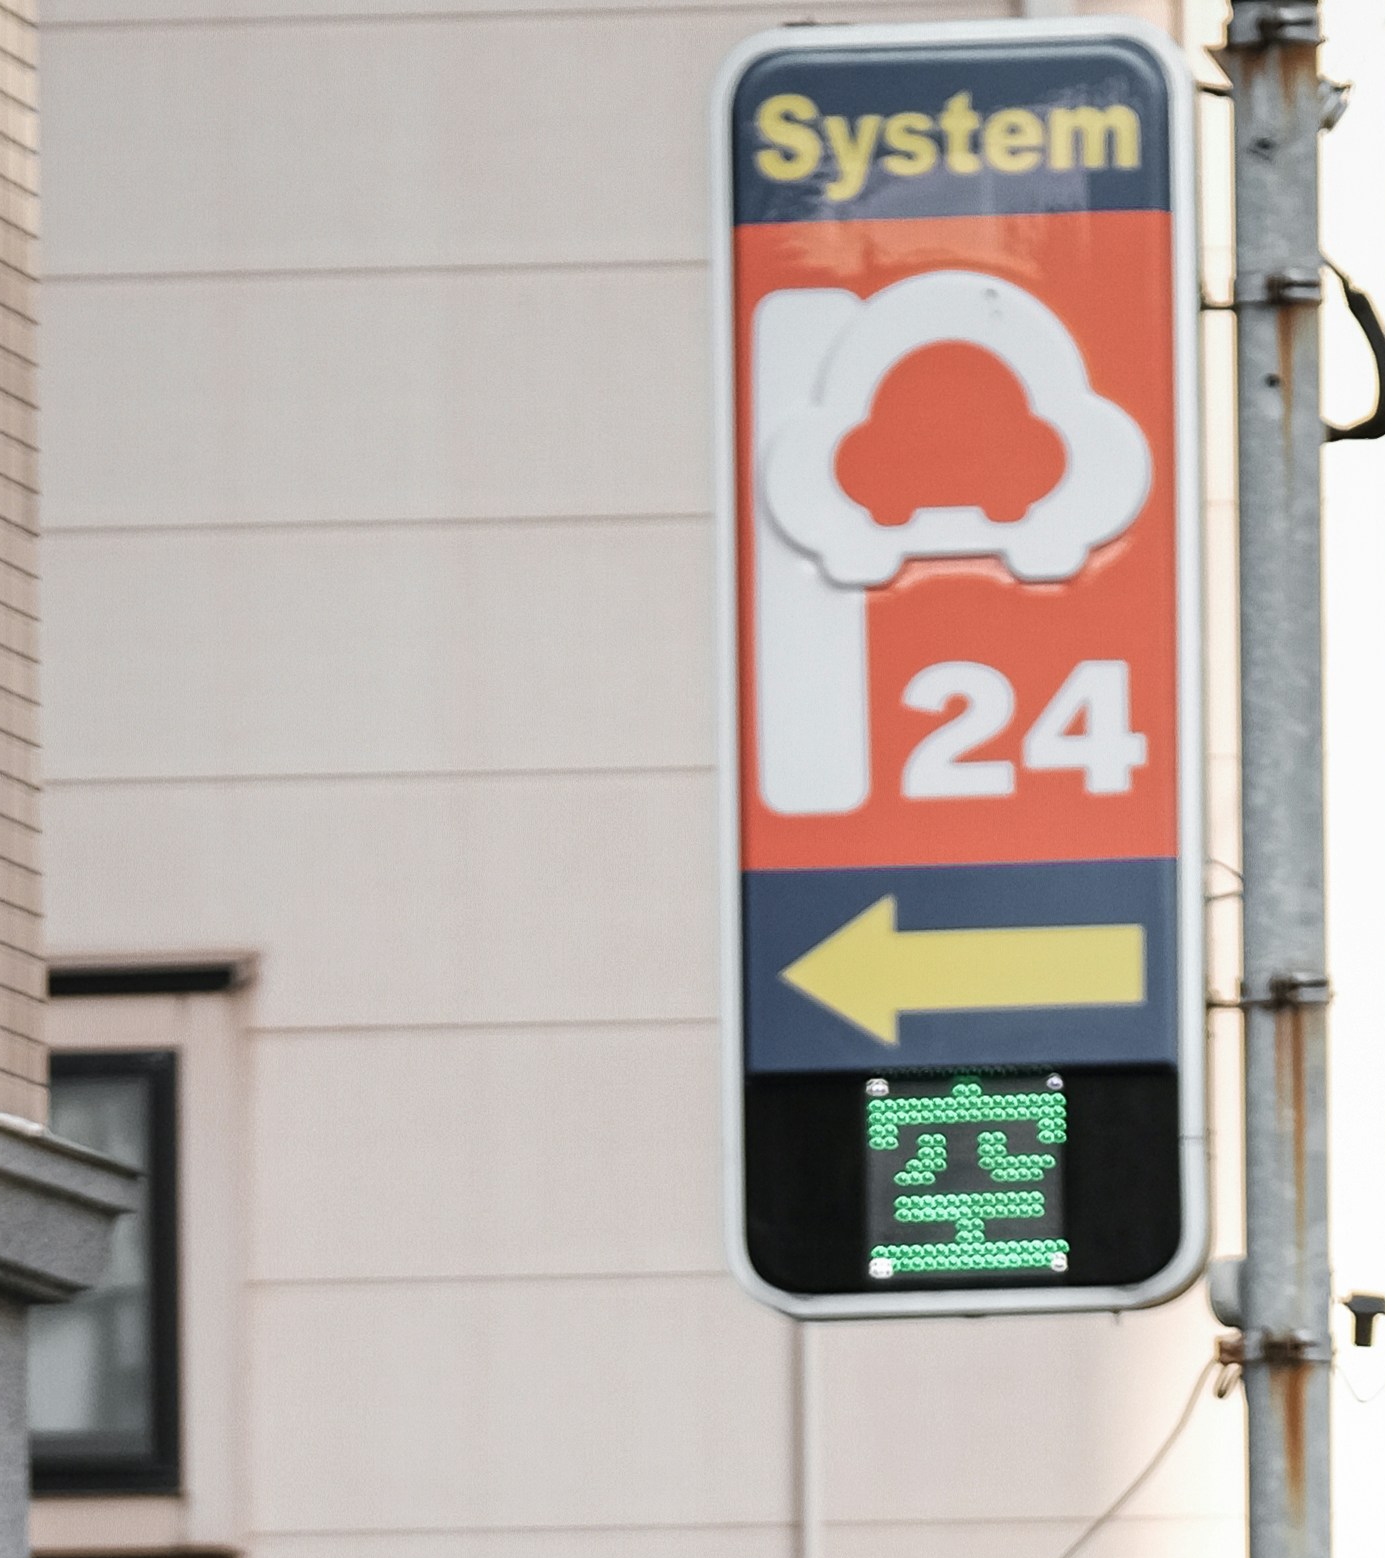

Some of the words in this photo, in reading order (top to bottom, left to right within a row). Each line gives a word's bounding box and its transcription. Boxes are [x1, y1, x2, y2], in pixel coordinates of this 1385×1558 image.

[755, 92, 1140, 201] System
[900, 659, 1149, 800] 24
[867, 1083, 1069, 1271] 空
